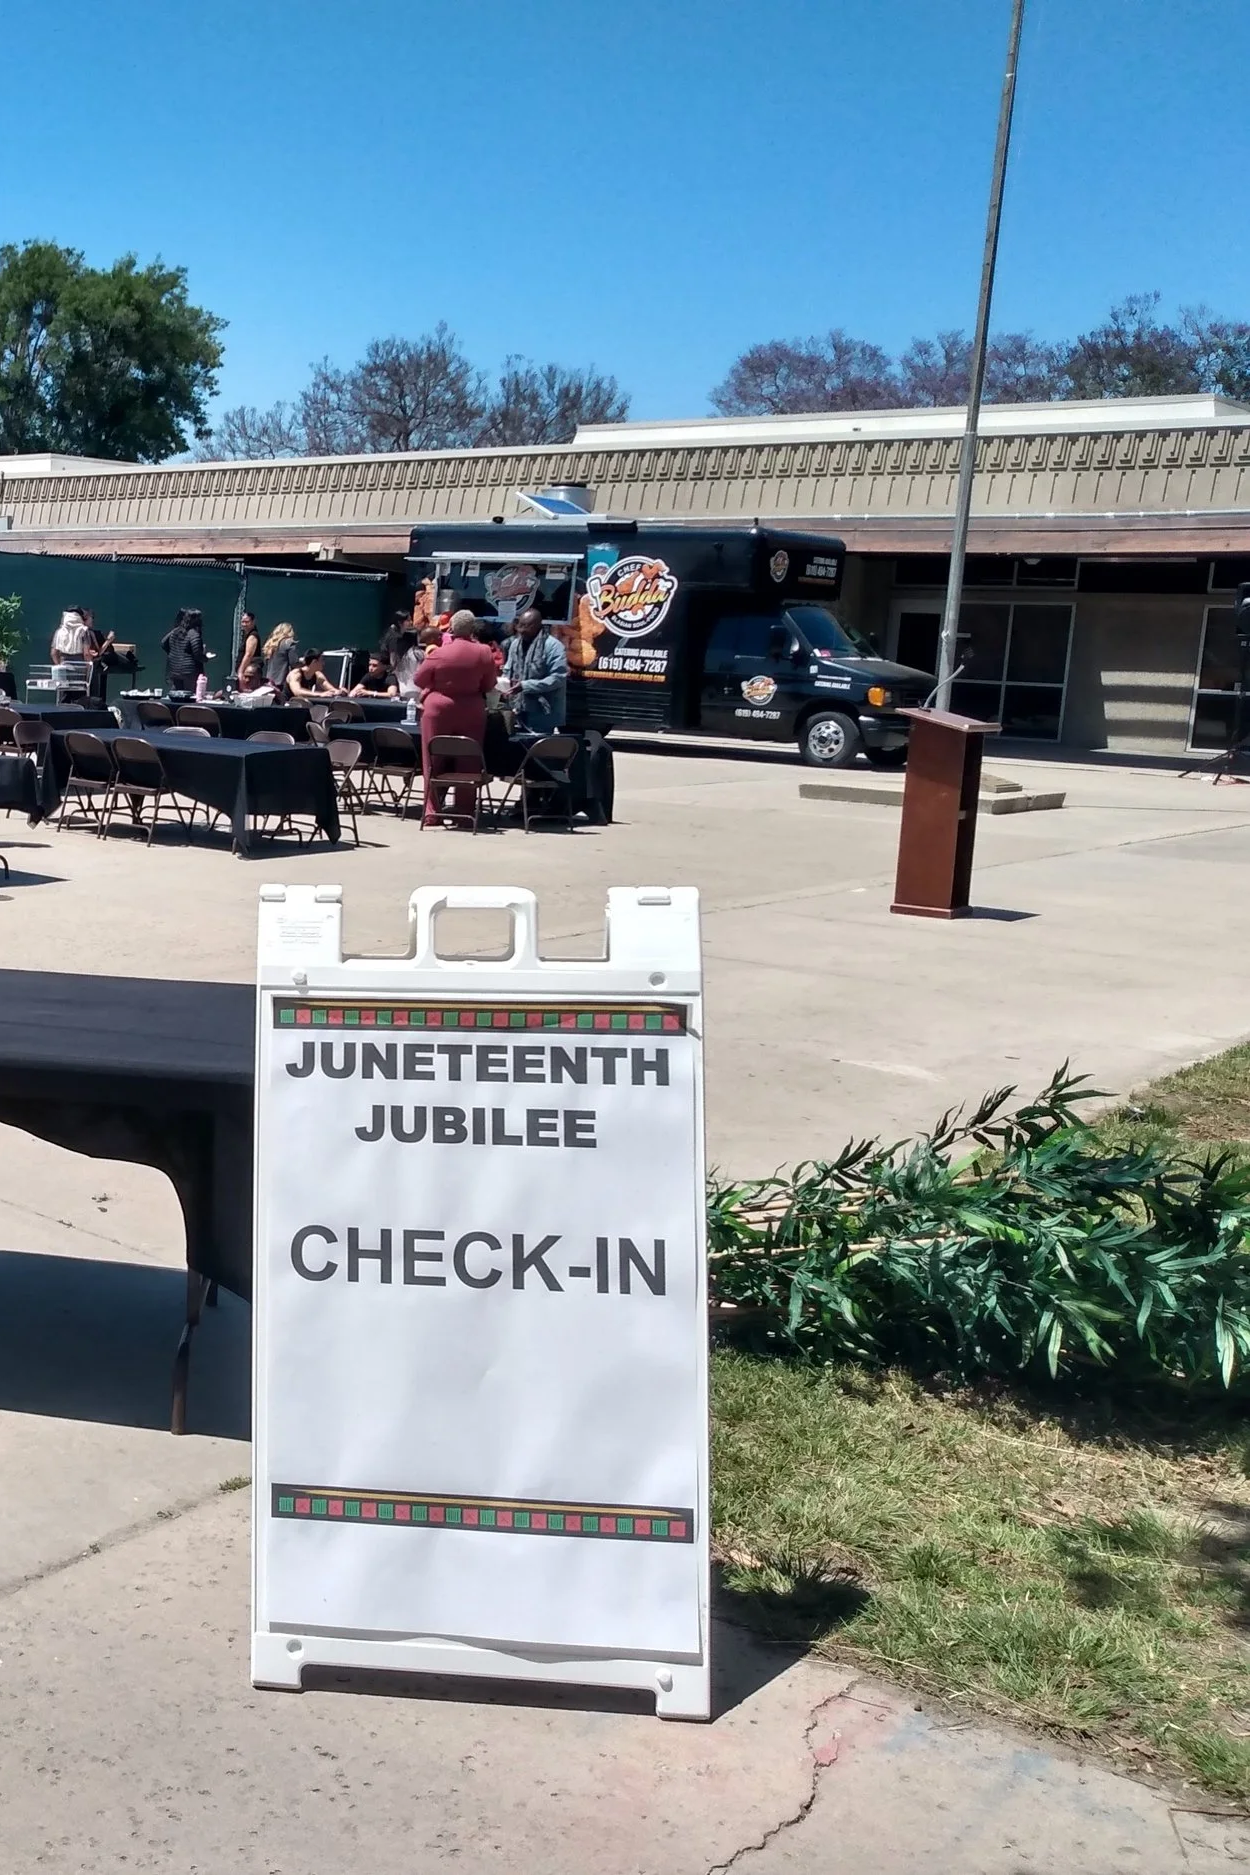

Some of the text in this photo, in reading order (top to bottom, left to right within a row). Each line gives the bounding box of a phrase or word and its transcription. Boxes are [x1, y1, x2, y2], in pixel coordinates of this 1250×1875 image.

[617, 563, 642, 577] CHEF
[594, 578, 669, 617] Budda
[598, 656, 667, 673] (619) 494-7287
[286, 1042, 670, 1086] JUNETEENTH
[355, 1105, 597, 1148] JUBILEE
[291, 1225, 667, 1296] CHECK-IN
